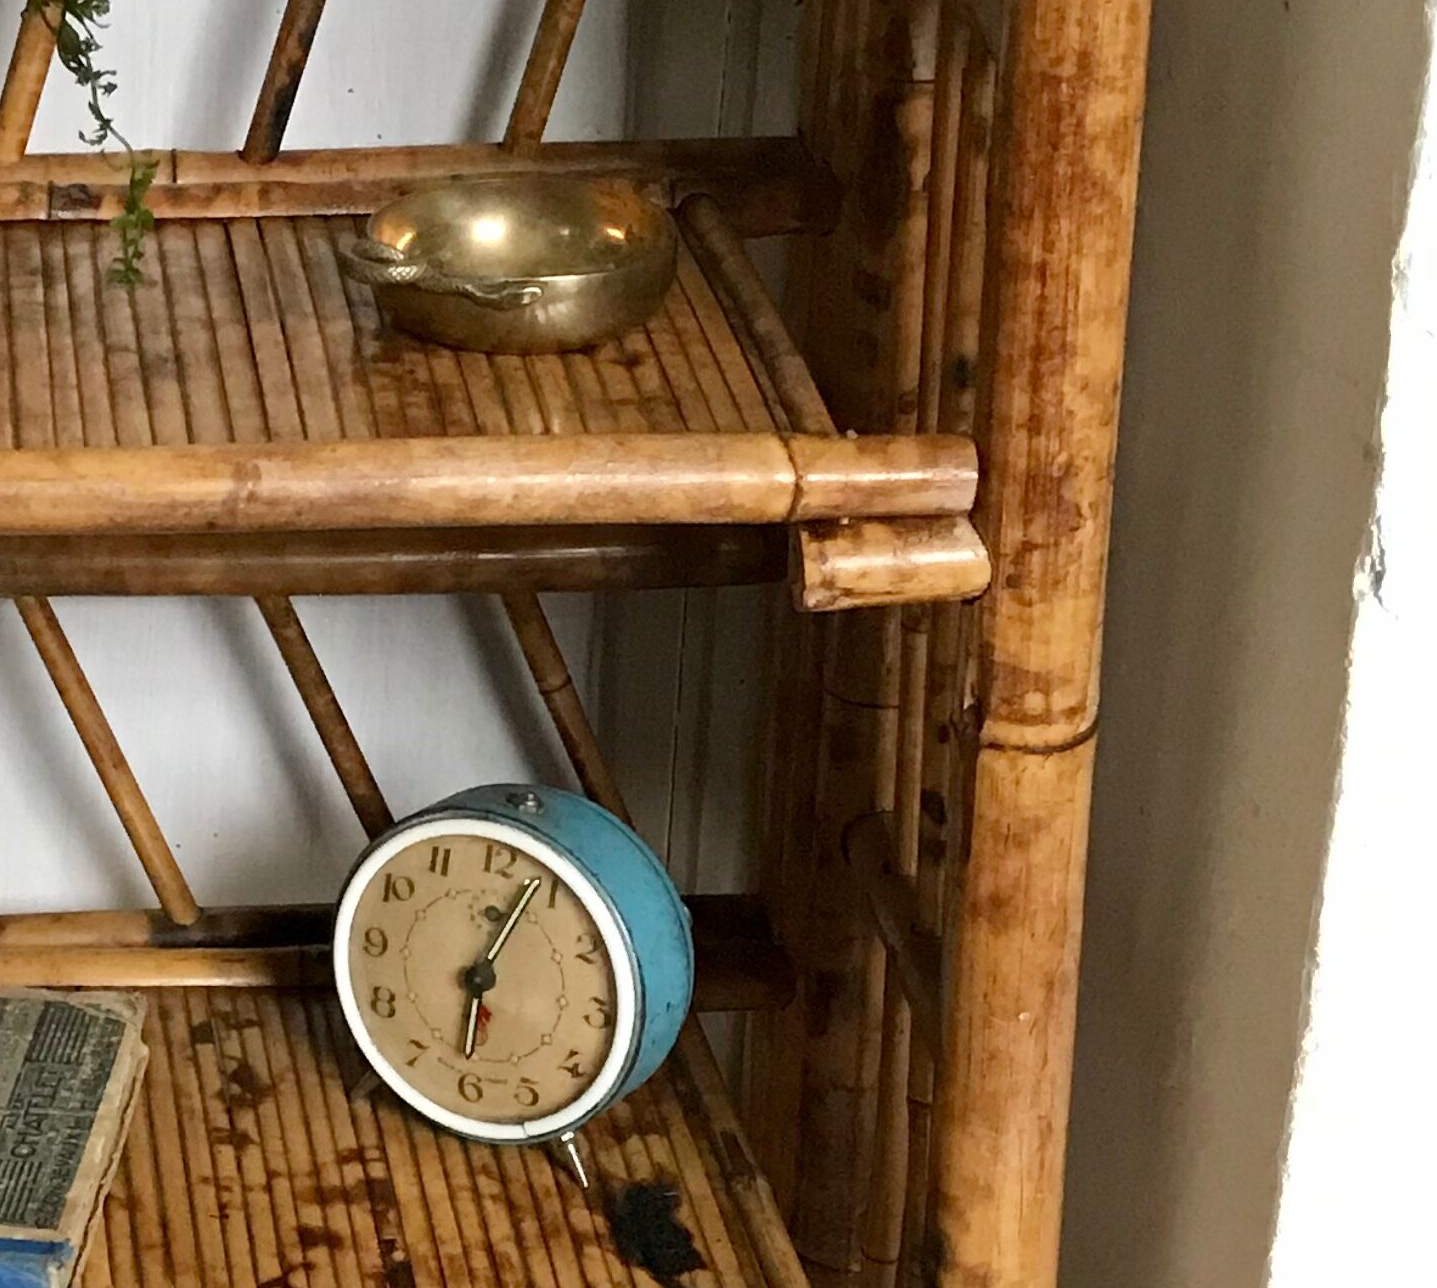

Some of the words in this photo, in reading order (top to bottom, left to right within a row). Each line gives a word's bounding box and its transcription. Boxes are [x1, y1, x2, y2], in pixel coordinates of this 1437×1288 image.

[428, 846, 451, 877] 11
[482, 844, 518, 880] 12
[382, 873, 415, 903] 10
[547, 879, 559, 909] 1
[363, 926, 389, 958] 9
[575, 932, 607, 965] 2
[370, 985, 396, 1019] 8
[582, 996, 612, 1029] 3
[405, 1038, 431, 1067] 7
[559, 1049, 586, 1079] 4
[457, 1073, 484, 1103] 6
[513, 1077, 540, 1107] 5
